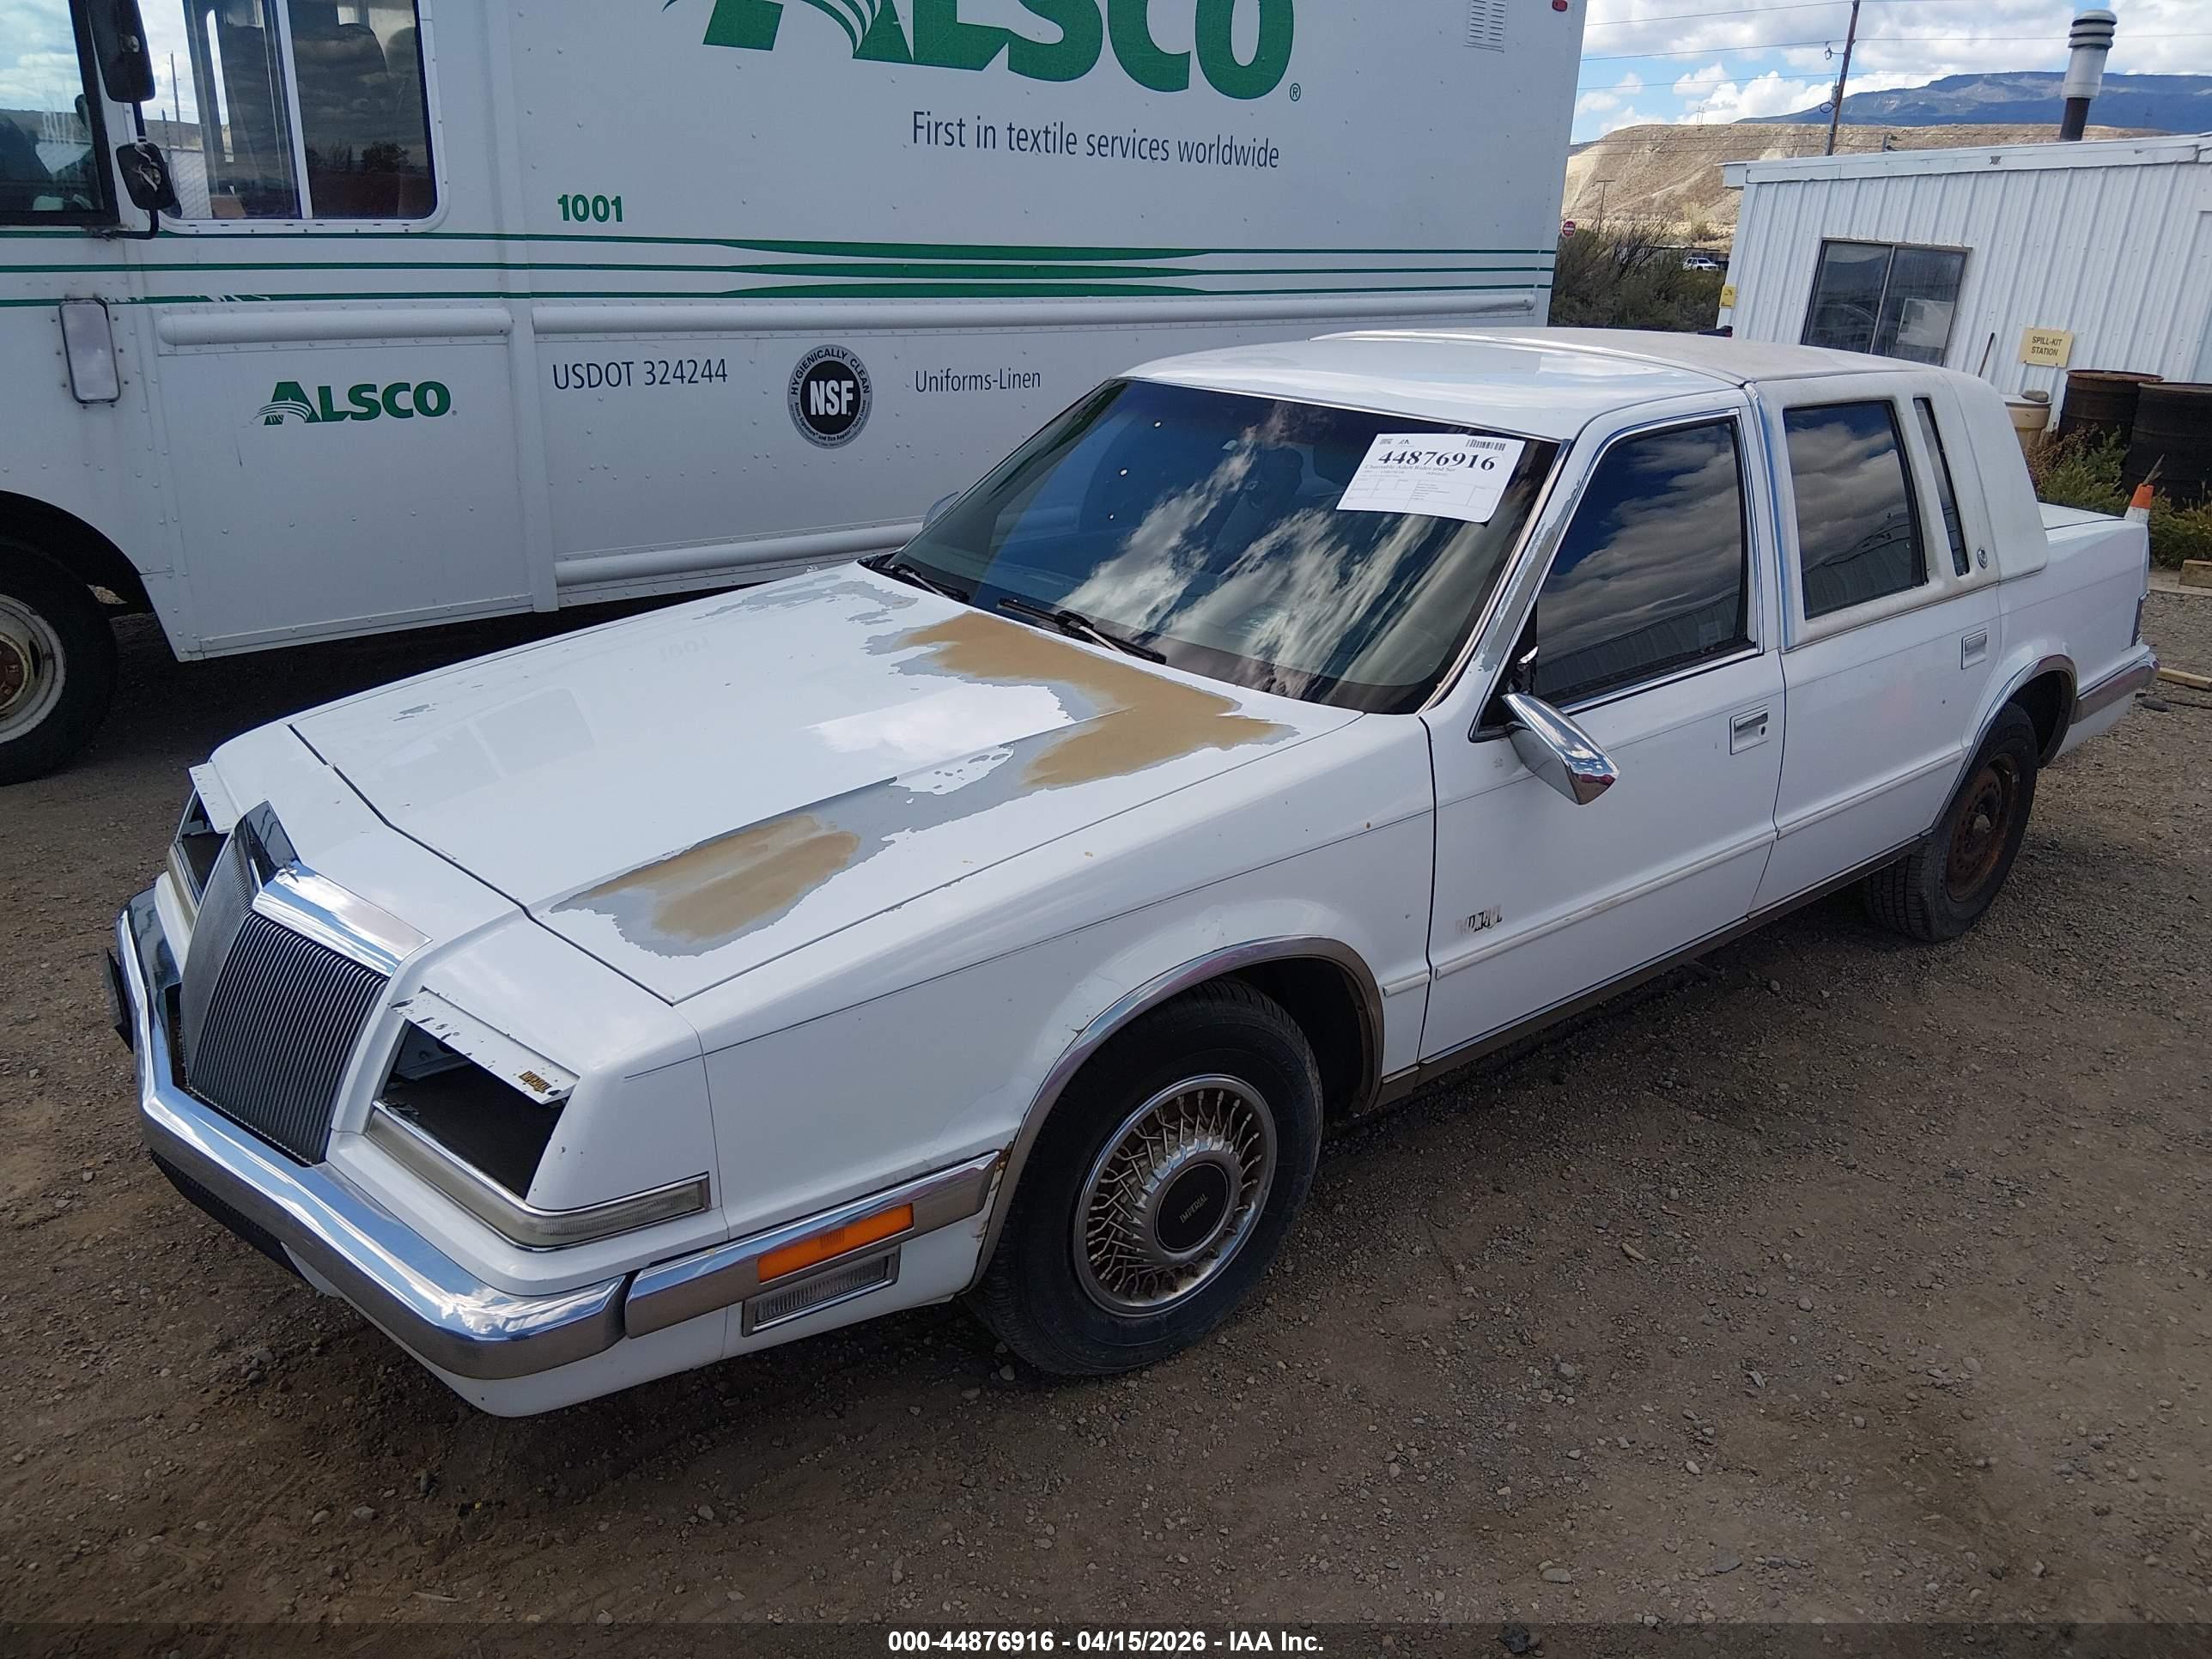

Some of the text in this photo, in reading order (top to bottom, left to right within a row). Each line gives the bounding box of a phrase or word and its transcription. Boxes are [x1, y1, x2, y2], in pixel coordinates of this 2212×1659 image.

[913, 110, 1279, 168] First in textile services worldwide
[557, 193, 623, 223] 1001
[2031, 346, 2059, 356] STATION
[2032, 336, 2063, 347] SPILL-KIT
[552, 358, 728, 390] USDOT 324244
[791, 348, 871, 395] HYGIENICALLY CLEAN
[915, 367, 1041, 393] Uniforms-Linen
[254, 380, 451, 426] ALSCO
[810, 380, 854, 416] NSF
[1378, 450, 1498, 471] 44876916
